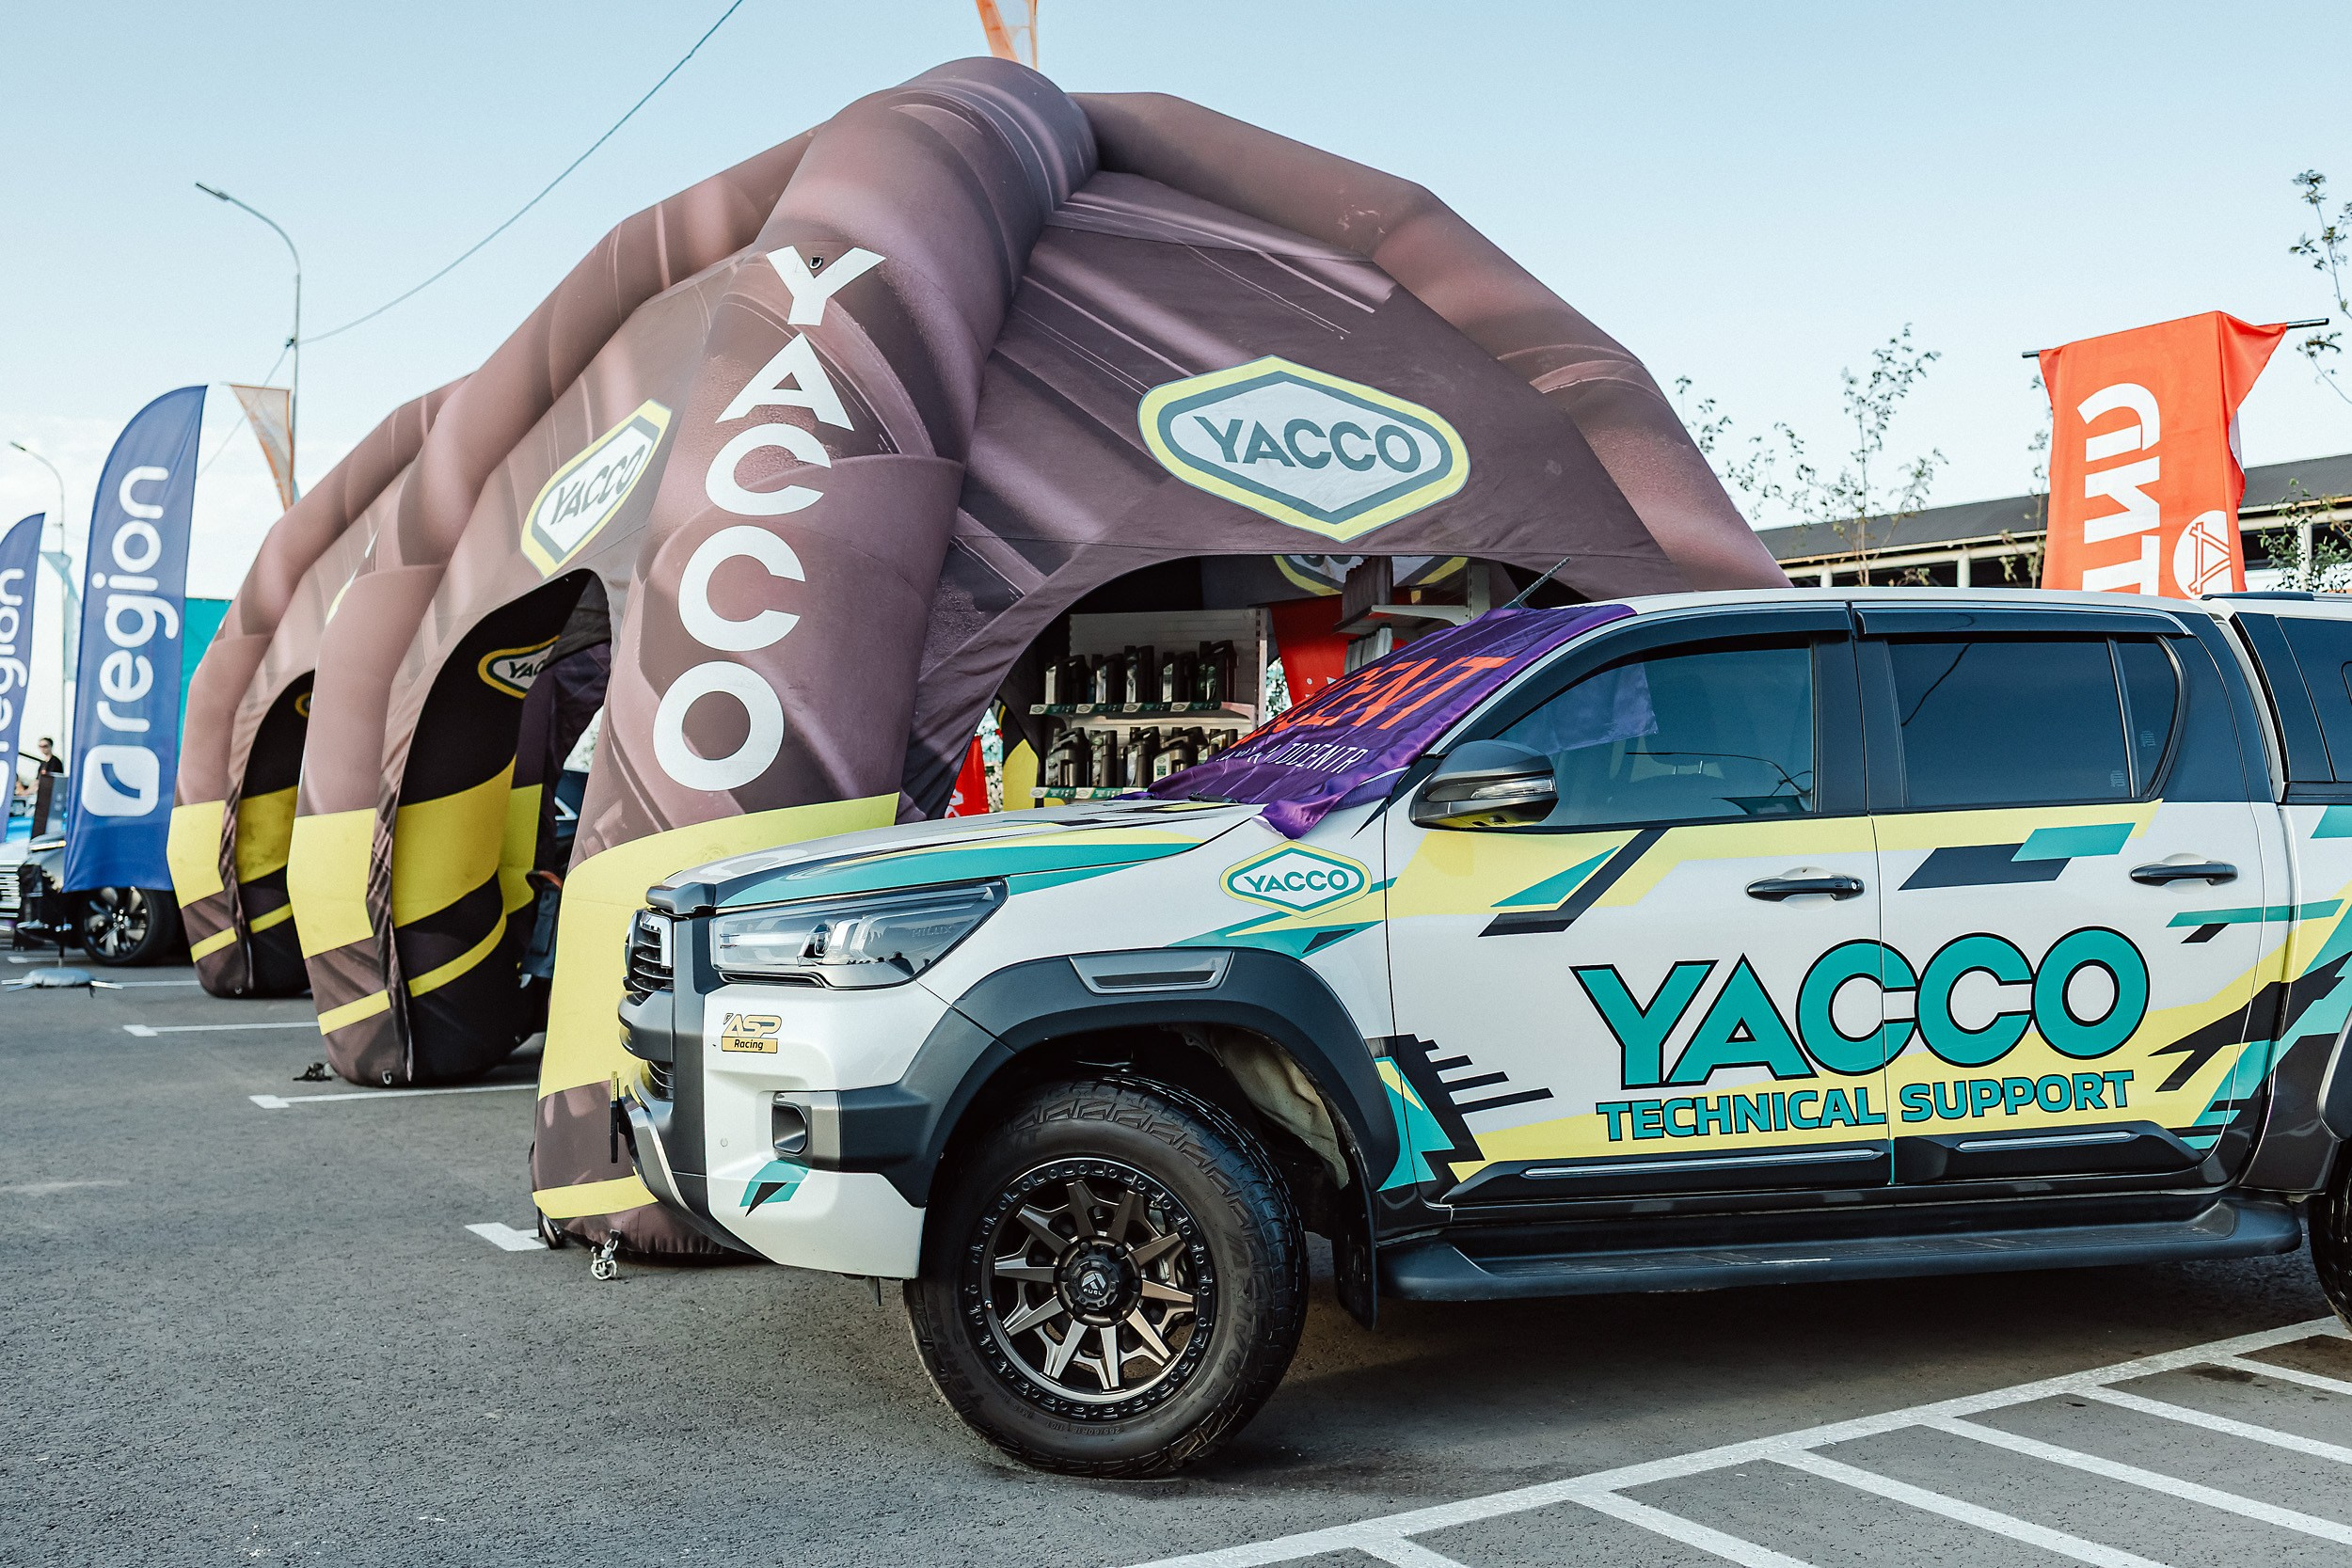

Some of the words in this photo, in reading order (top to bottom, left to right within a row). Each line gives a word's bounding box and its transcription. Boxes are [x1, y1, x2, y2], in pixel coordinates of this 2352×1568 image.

[1193, 416, 1422, 473] YACCO
[549, 444, 645, 526] YACCO
[653, 245, 886, 792] YACCO
[92, 466, 179, 733] region
[509, 658, 548, 678] YAC
[1244, 869, 1349, 893] YACCO
[722, 1013, 782, 1037] ASP
[1569, 926, 2150, 1090] YACCO
[734, 1038, 764, 1051] Racing
[1597, 1085, 1887, 1143] TECHNICAL
[1900, 1069, 2134, 1123] SUPPORT
[1083, 1288, 1103, 1296] FUEL
